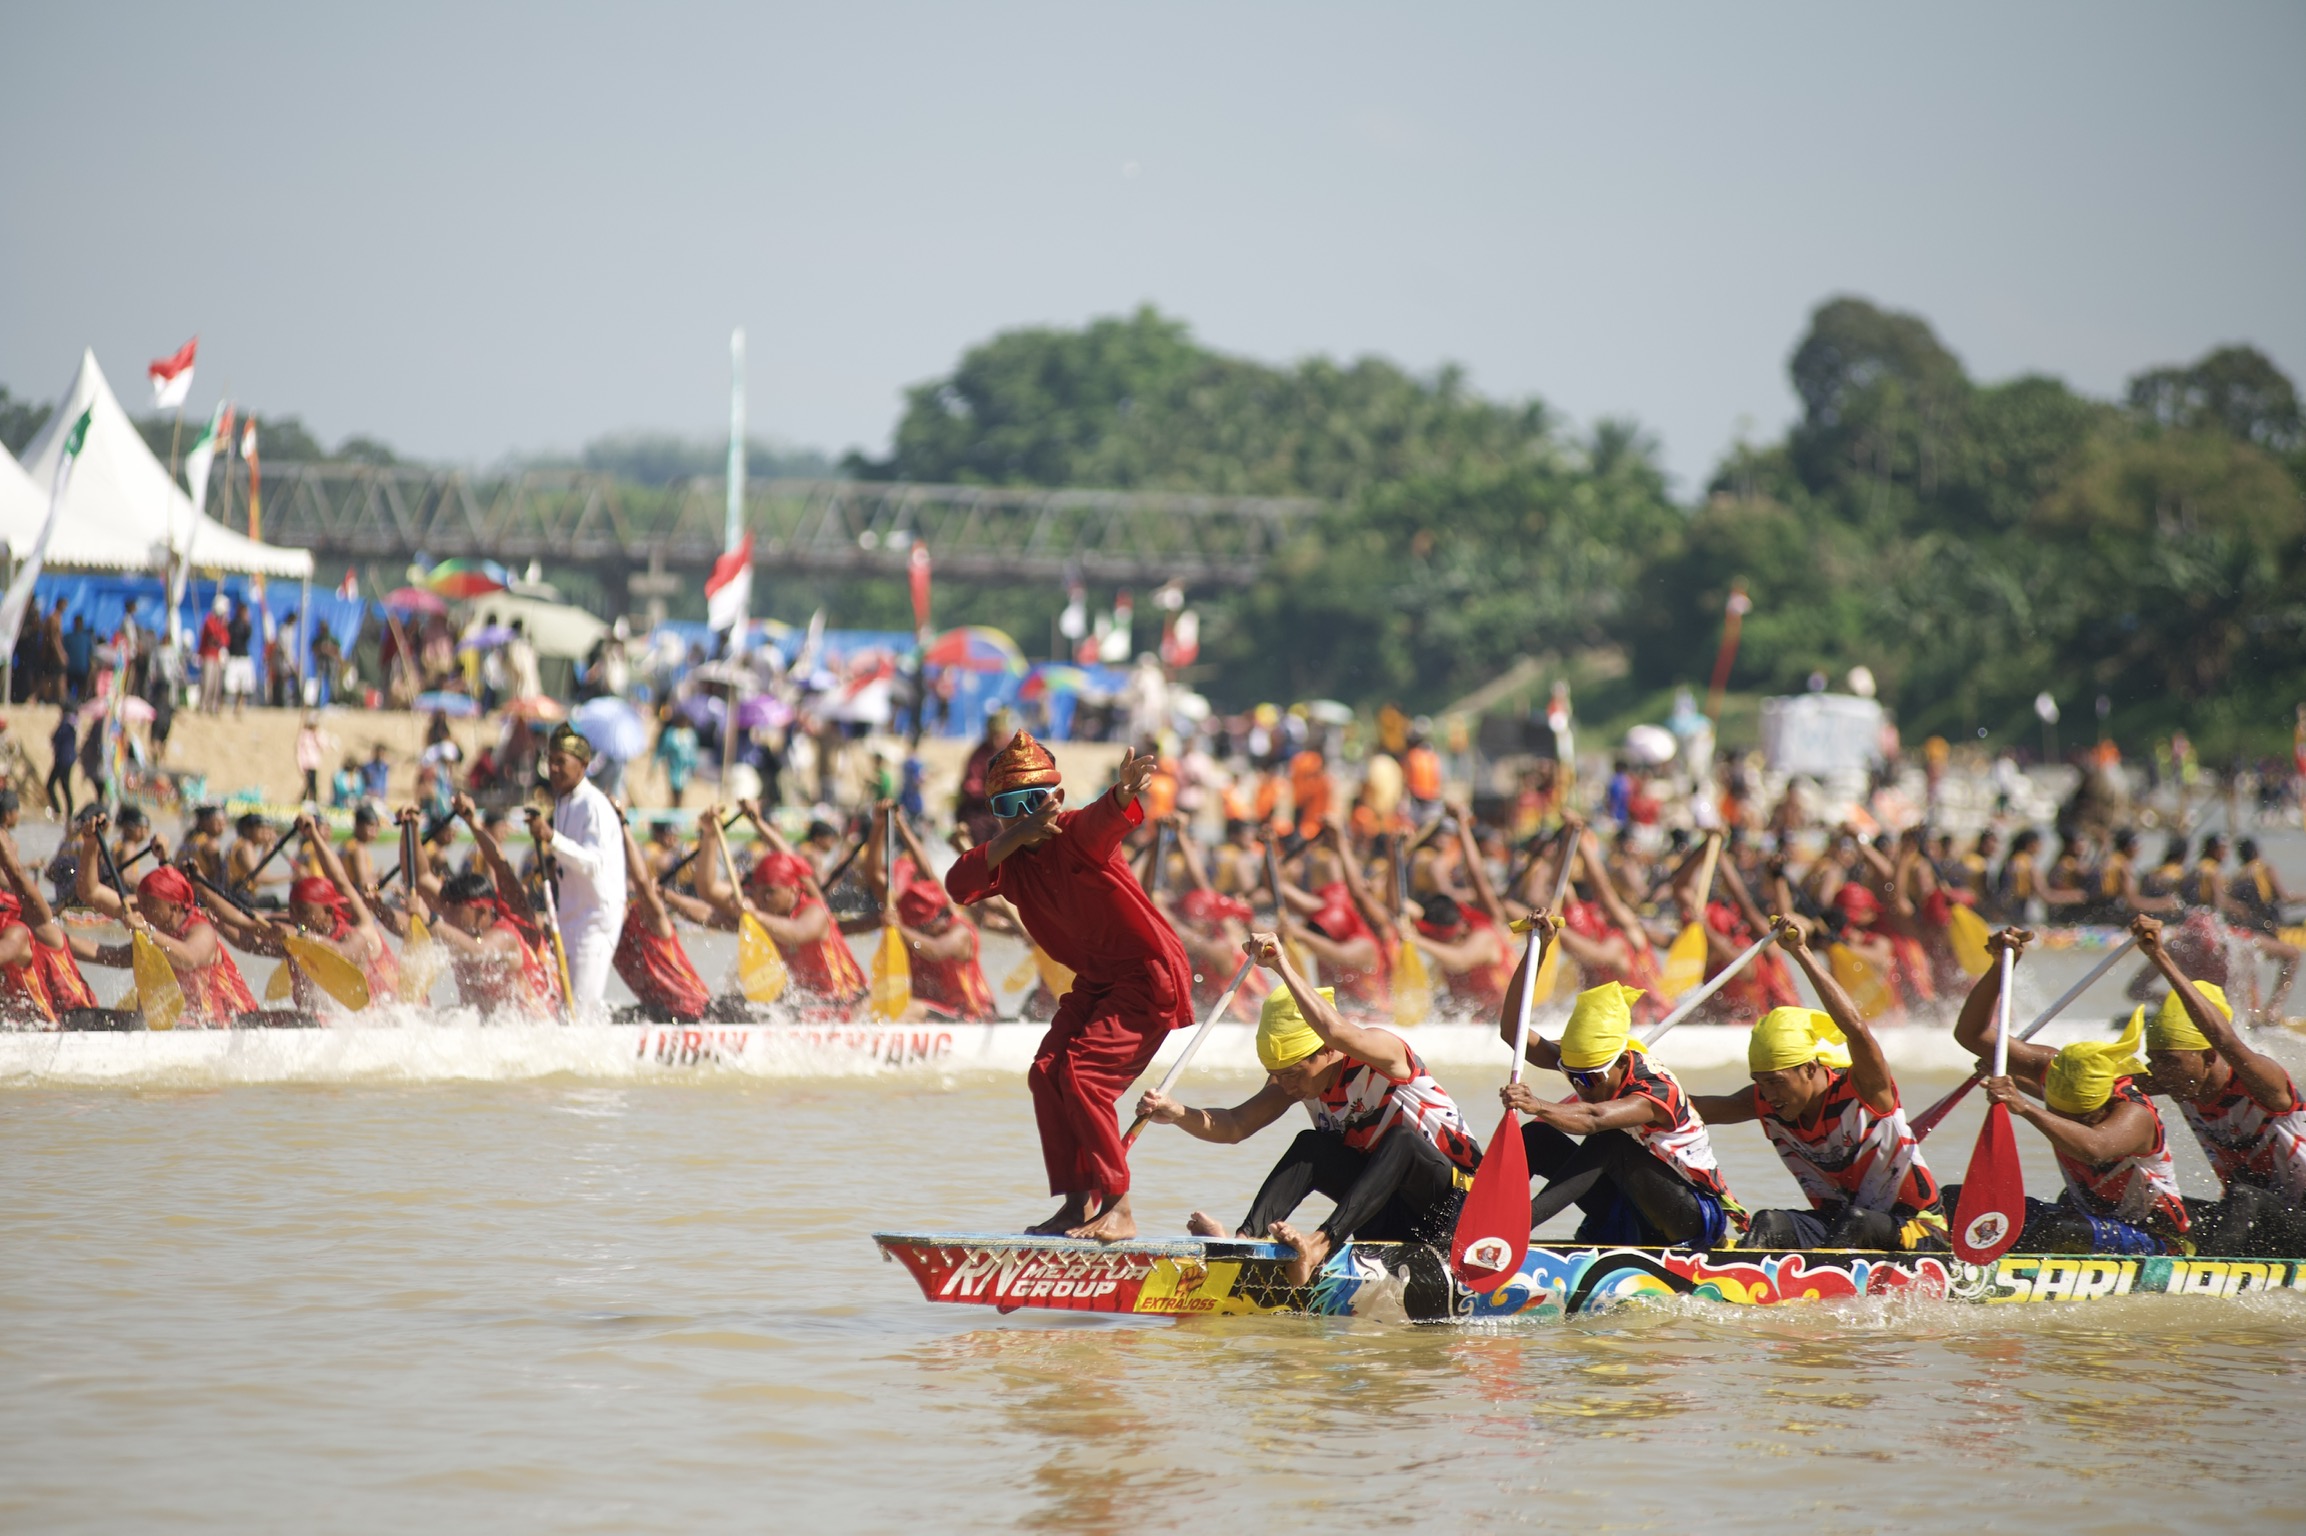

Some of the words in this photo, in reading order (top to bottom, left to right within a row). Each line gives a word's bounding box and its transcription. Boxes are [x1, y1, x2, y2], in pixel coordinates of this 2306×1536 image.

[1021, 1263, 1152, 1281] MERTUA
[1986, 1258, 2138, 1303] SARI
[1010, 1280, 1118, 1298] GROUP
